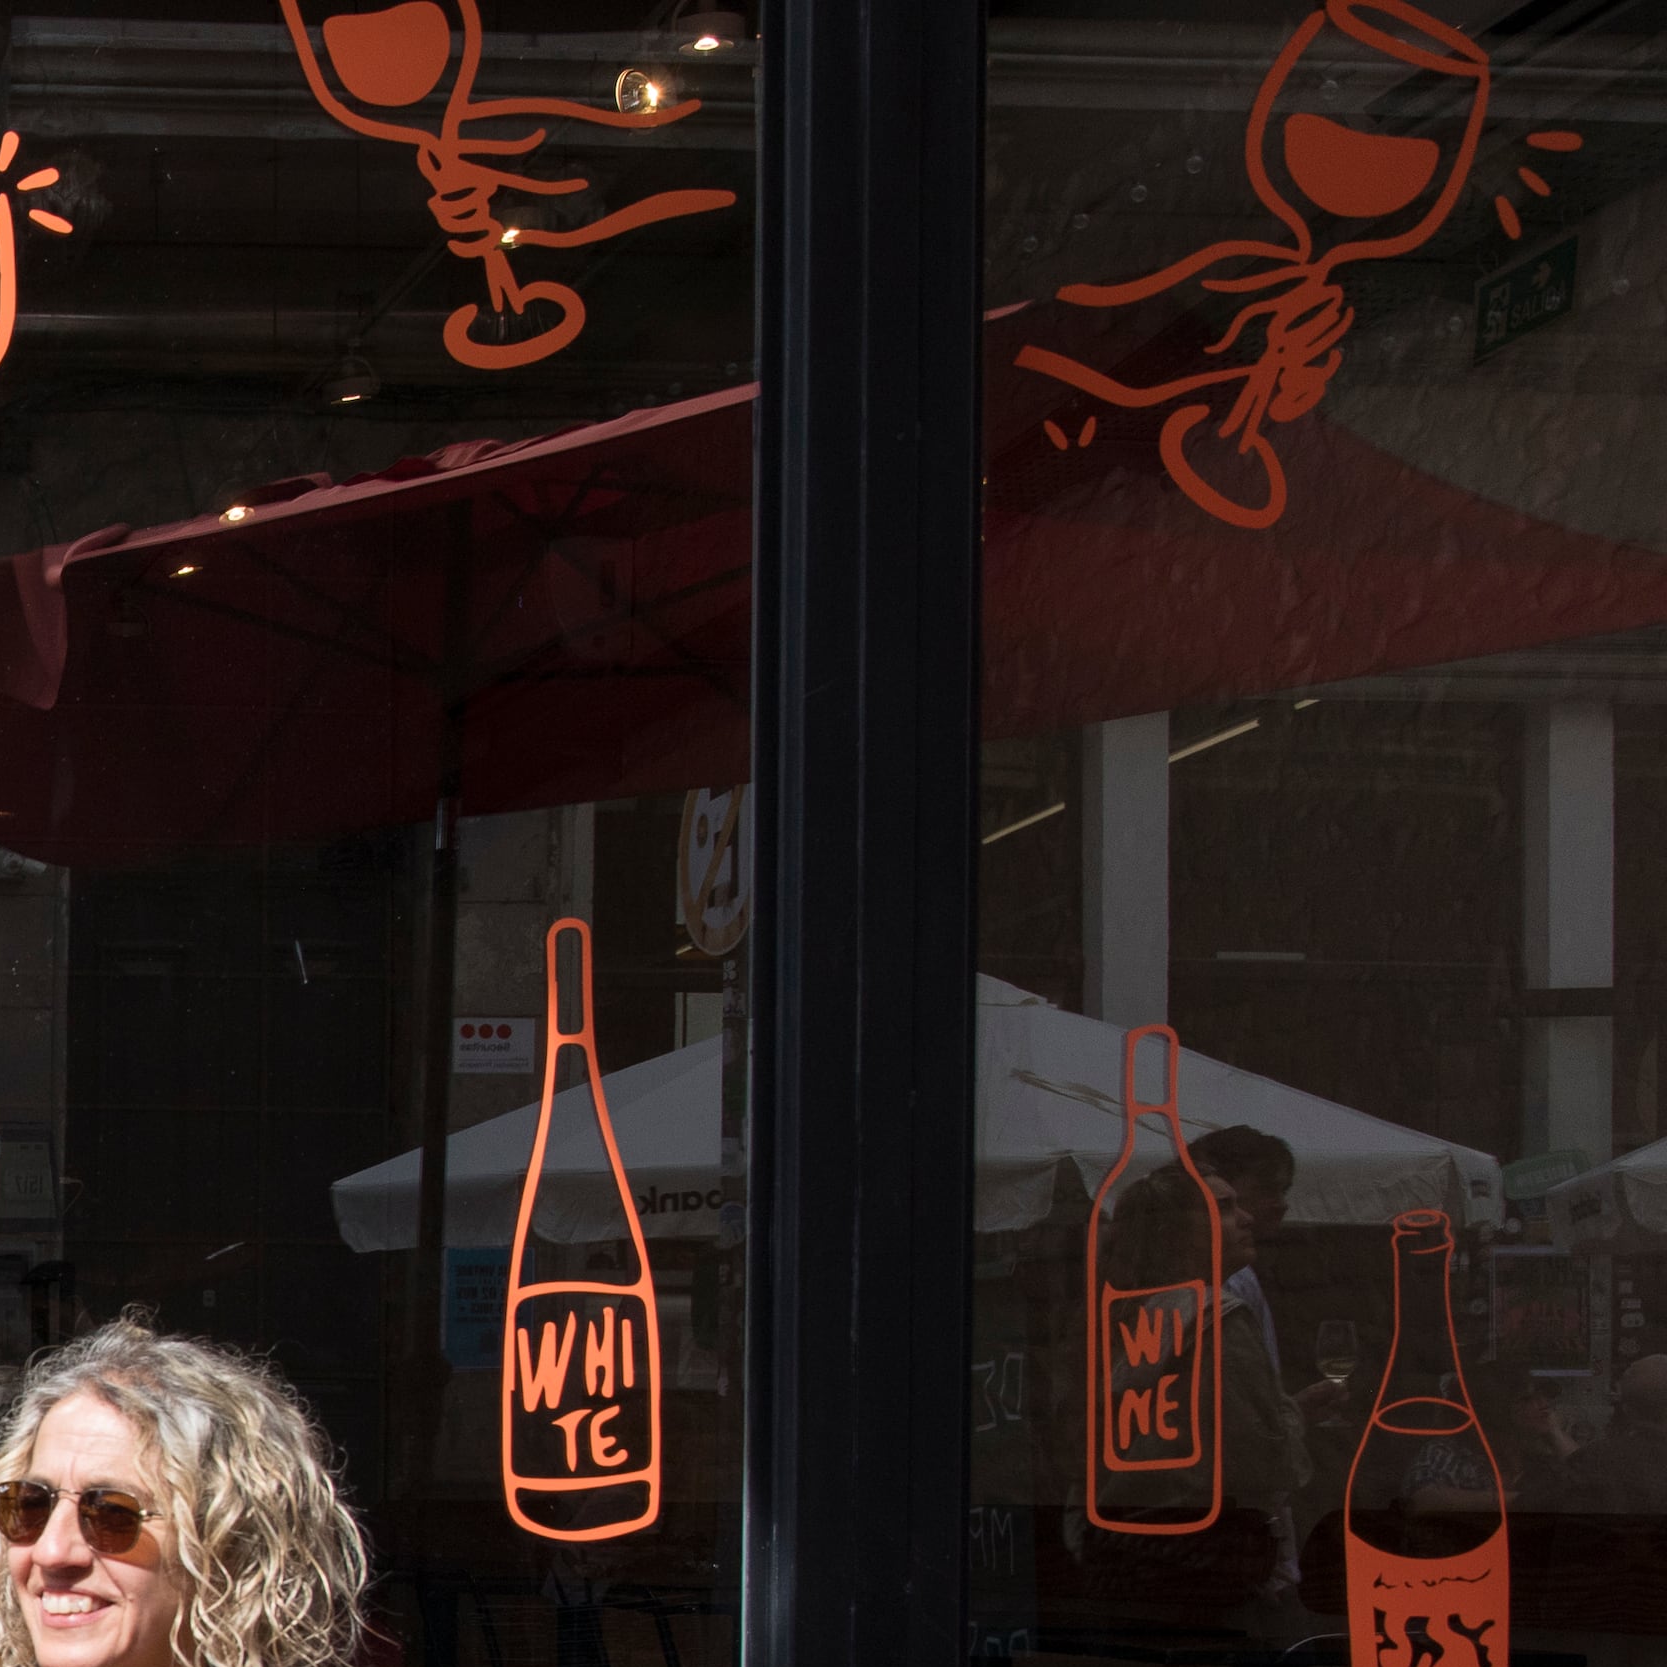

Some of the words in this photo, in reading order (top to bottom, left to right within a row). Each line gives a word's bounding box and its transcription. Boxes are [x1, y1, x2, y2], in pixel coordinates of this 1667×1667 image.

[516, 1306, 634, 1412] WHI
[1119, 1305, 1184, 1369] WI
[551, 1406, 629, 1473] TE
[1117, 1374, 1180, 1450] NE
